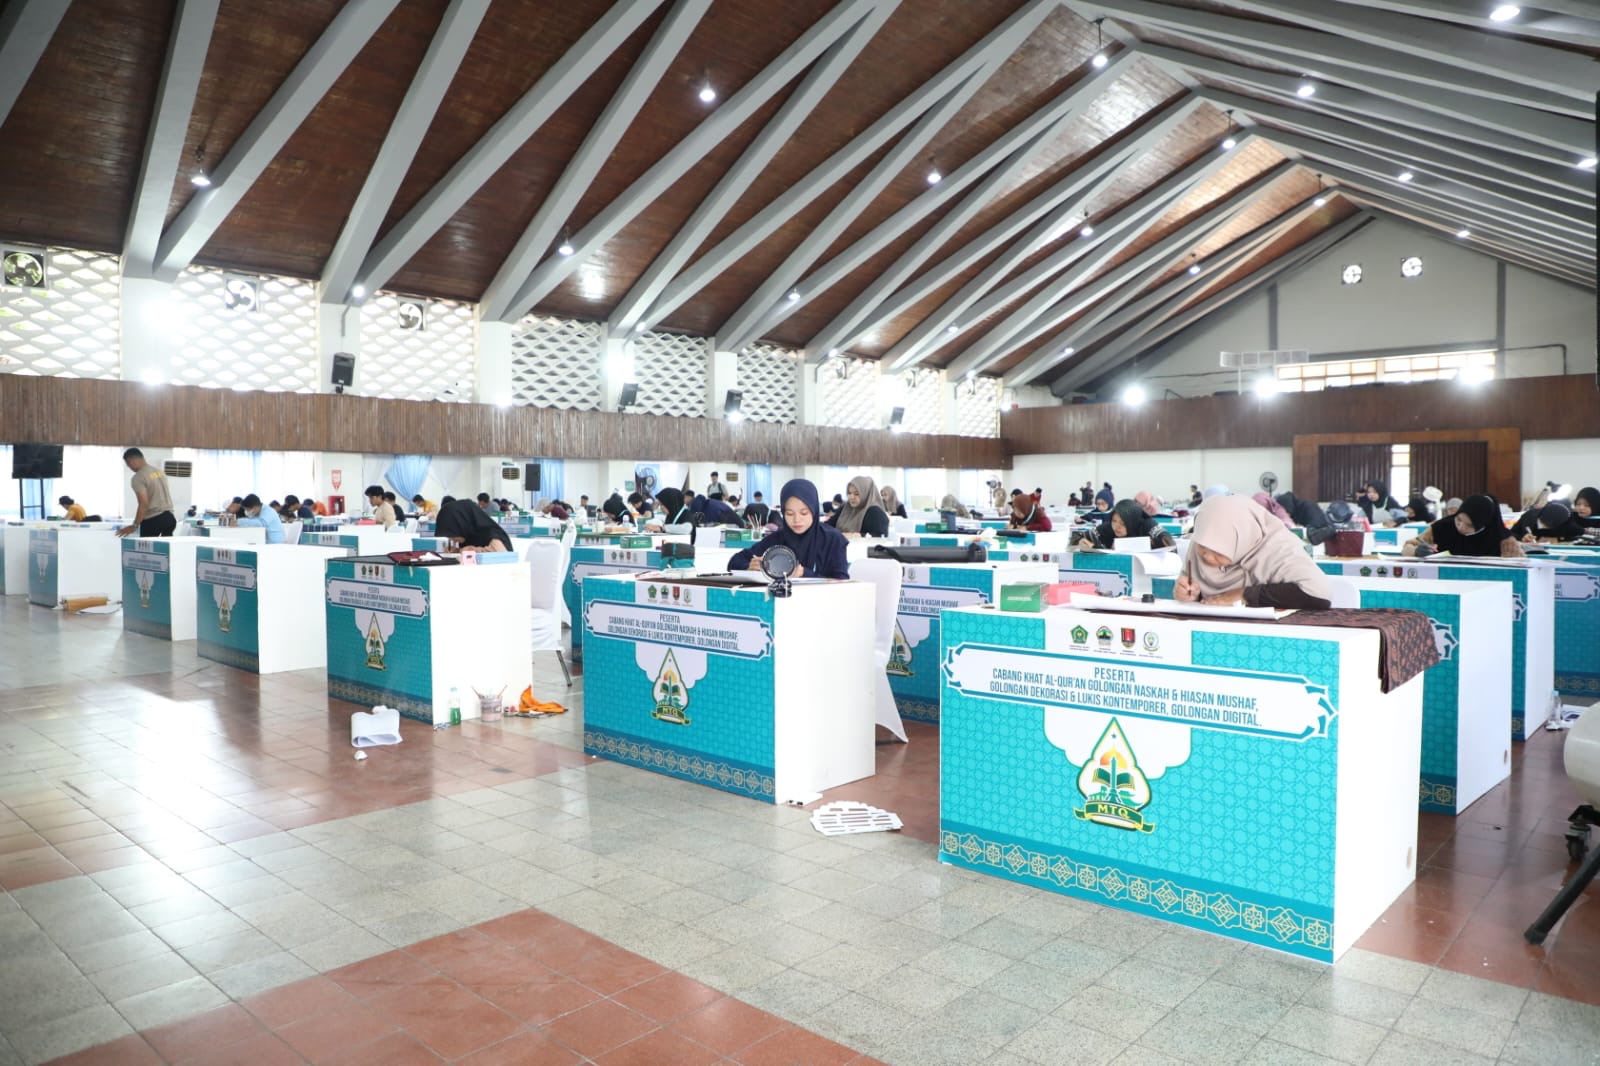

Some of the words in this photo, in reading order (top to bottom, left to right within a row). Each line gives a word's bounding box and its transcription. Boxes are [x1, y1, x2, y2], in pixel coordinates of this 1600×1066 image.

[609, 616, 624, 625] CABANG
[656, 621, 679, 632] GOLONGAN
[679, 624, 696, 635] NASKAH
[701, 627, 718, 636] HIASAN
[659, 613, 680, 623] PESERTA
[608, 625, 628, 634] GOLONGAN
[628, 627, 647, 637] DEKORASI
[651, 631, 664, 640] LUKIS
[697, 637, 721, 648] GOLONGAN
[1094, 667, 1136, 683] PESERTA
[993, 668, 1022, 682] CABANG
[1024, 672, 1043, 684] KHAT
[1045, 674, 1086, 690] AL-QUR'AN
[1088, 679, 1132, 696] GOLONGAN
[1134, 684, 1169, 700] NASKAH
[1172, 689, 1178, 701] &
[1180, 690, 1214, 706] HIASAN
[1217, 694, 1259, 711] MUSHAF,
[990, 681, 1028, 696] GOLONGAN
[1030, 686, 1068, 702] DEKORASI
[1071, 691, 1076, 702] &
[1078, 692, 1101, 706] LUKIS
[1103, 696, 1168, 716] KONTEMPORER,
[1171, 703, 1220, 721] GOLONGAN
[1222, 710, 1262, 727] DIGITAL.
[1098, 804, 1130, 819] MTQ
